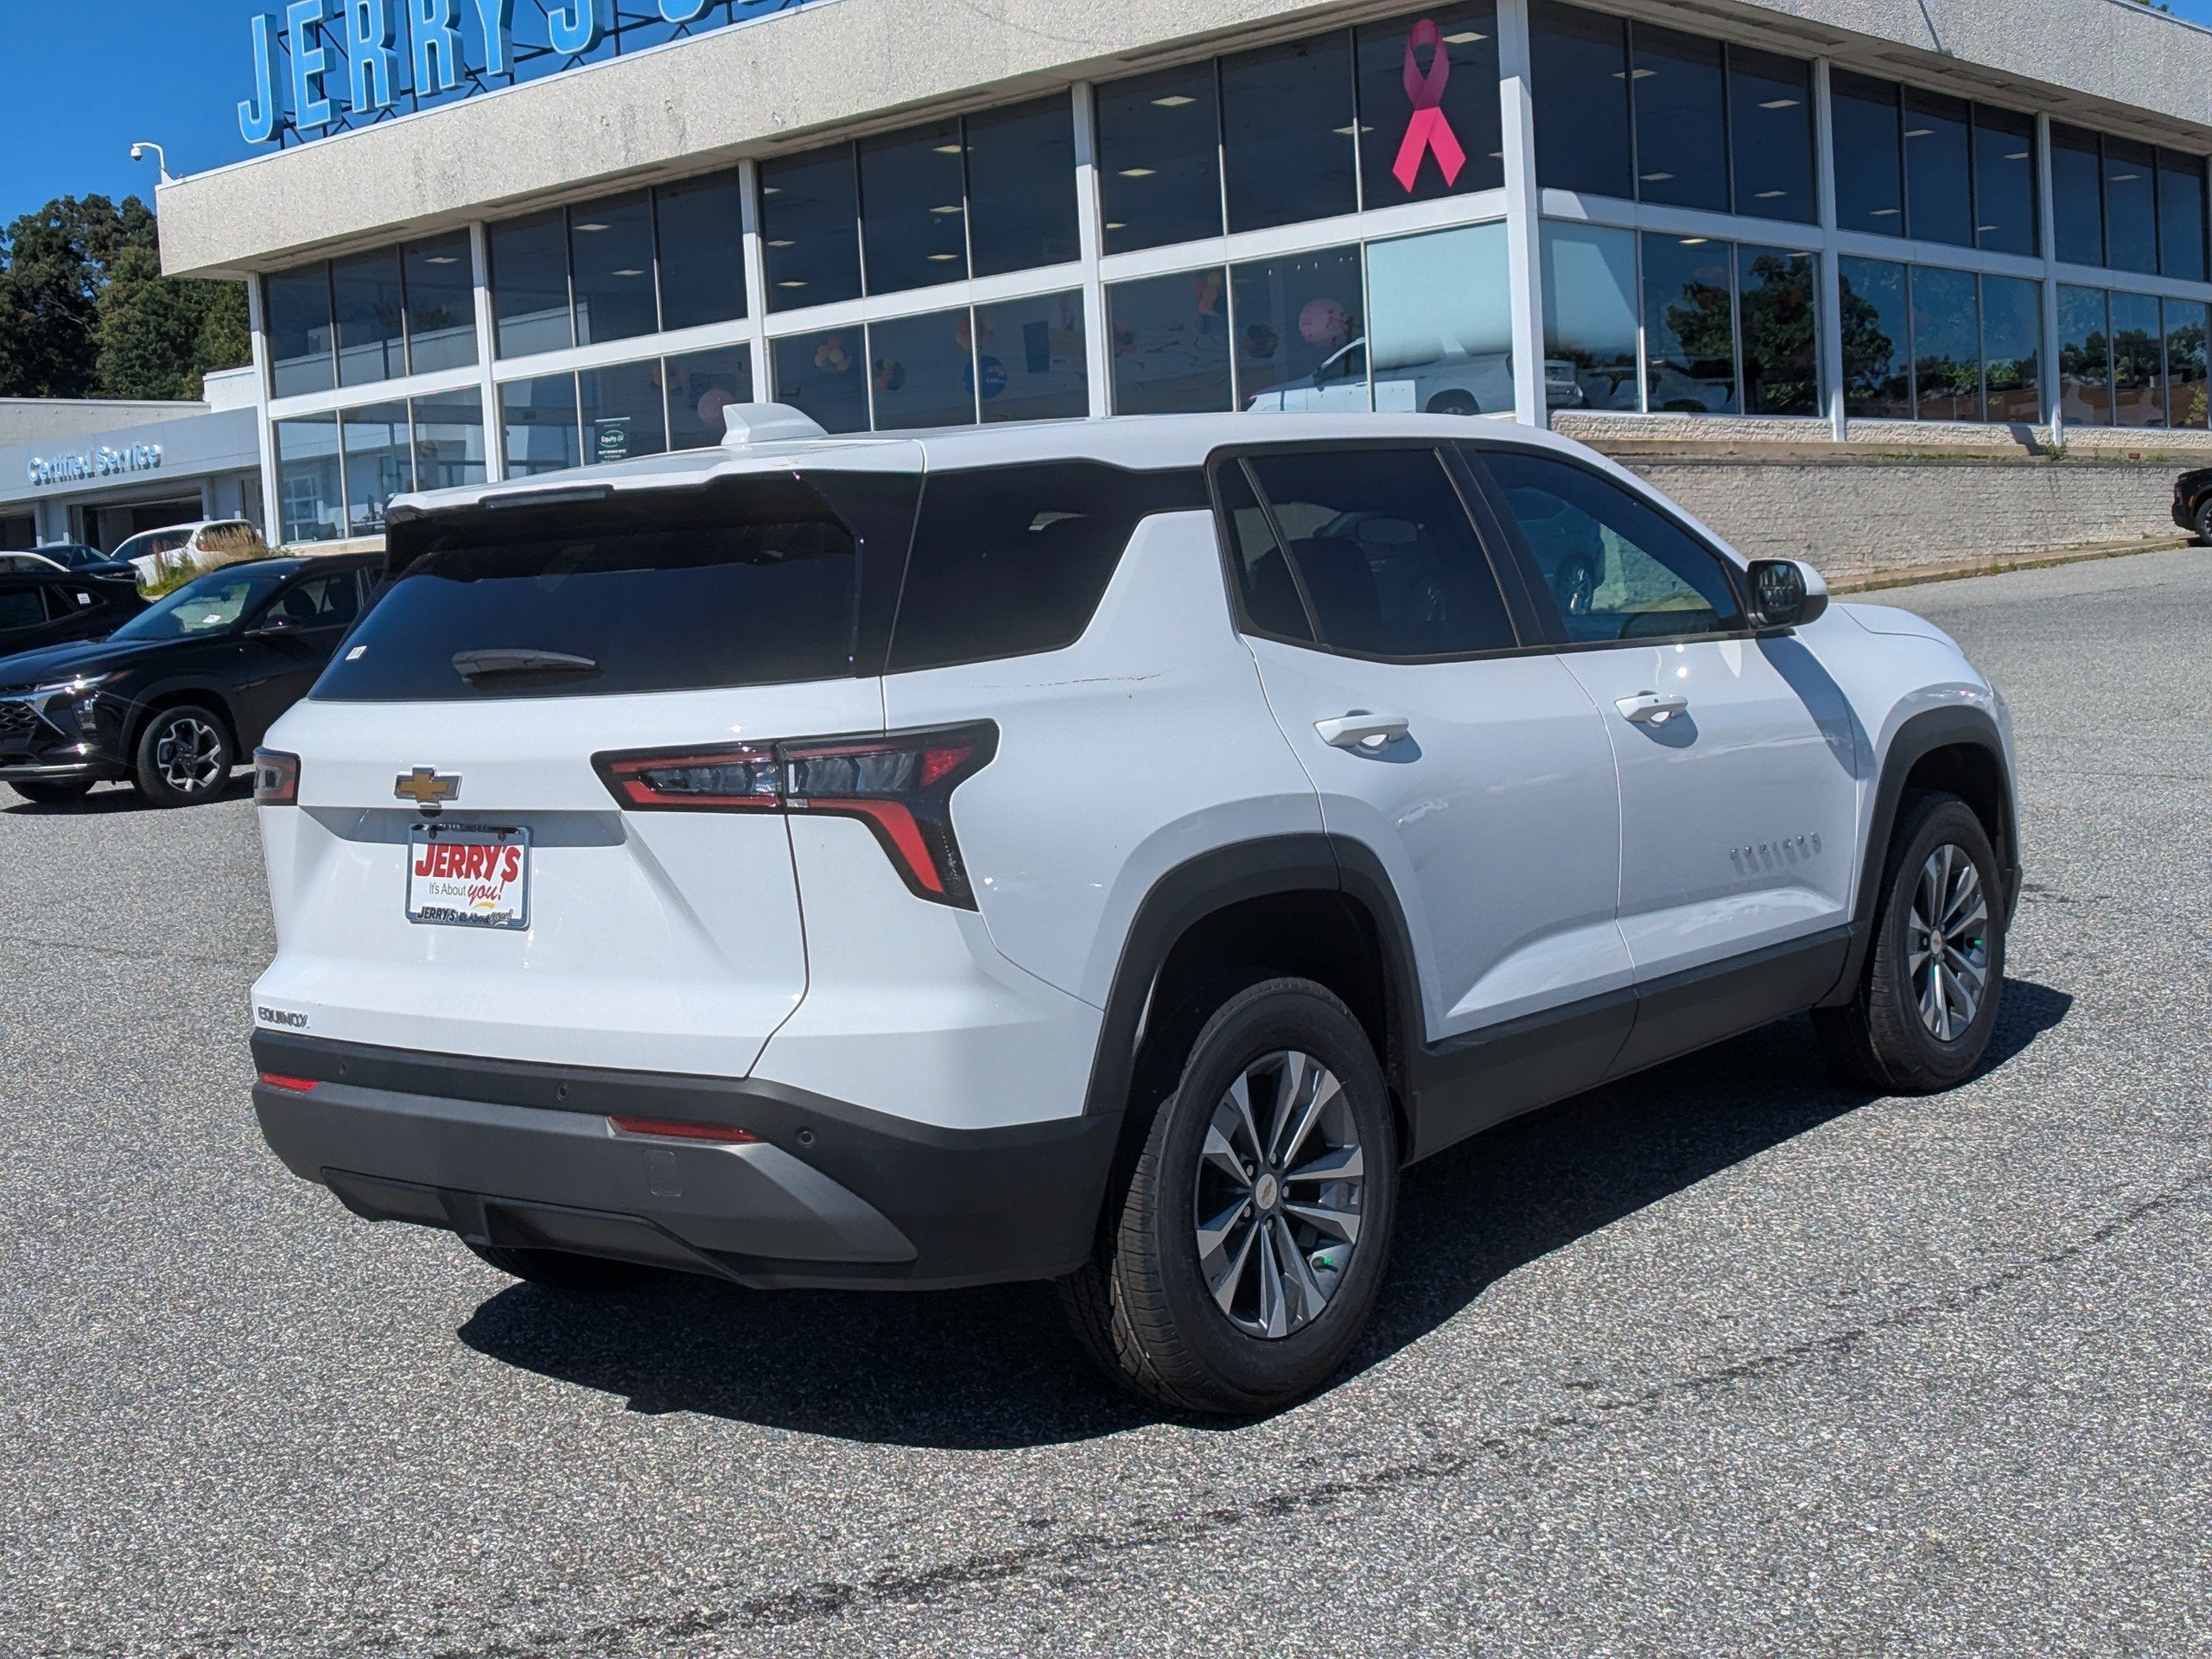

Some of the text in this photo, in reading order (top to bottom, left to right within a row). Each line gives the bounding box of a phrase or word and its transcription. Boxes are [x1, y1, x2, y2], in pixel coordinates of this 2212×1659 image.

[27, 441, 162, 484] Certified Service
[415, 842, 521, 882] JERRY'S
[429, 879, 506, 906] It's About you!
